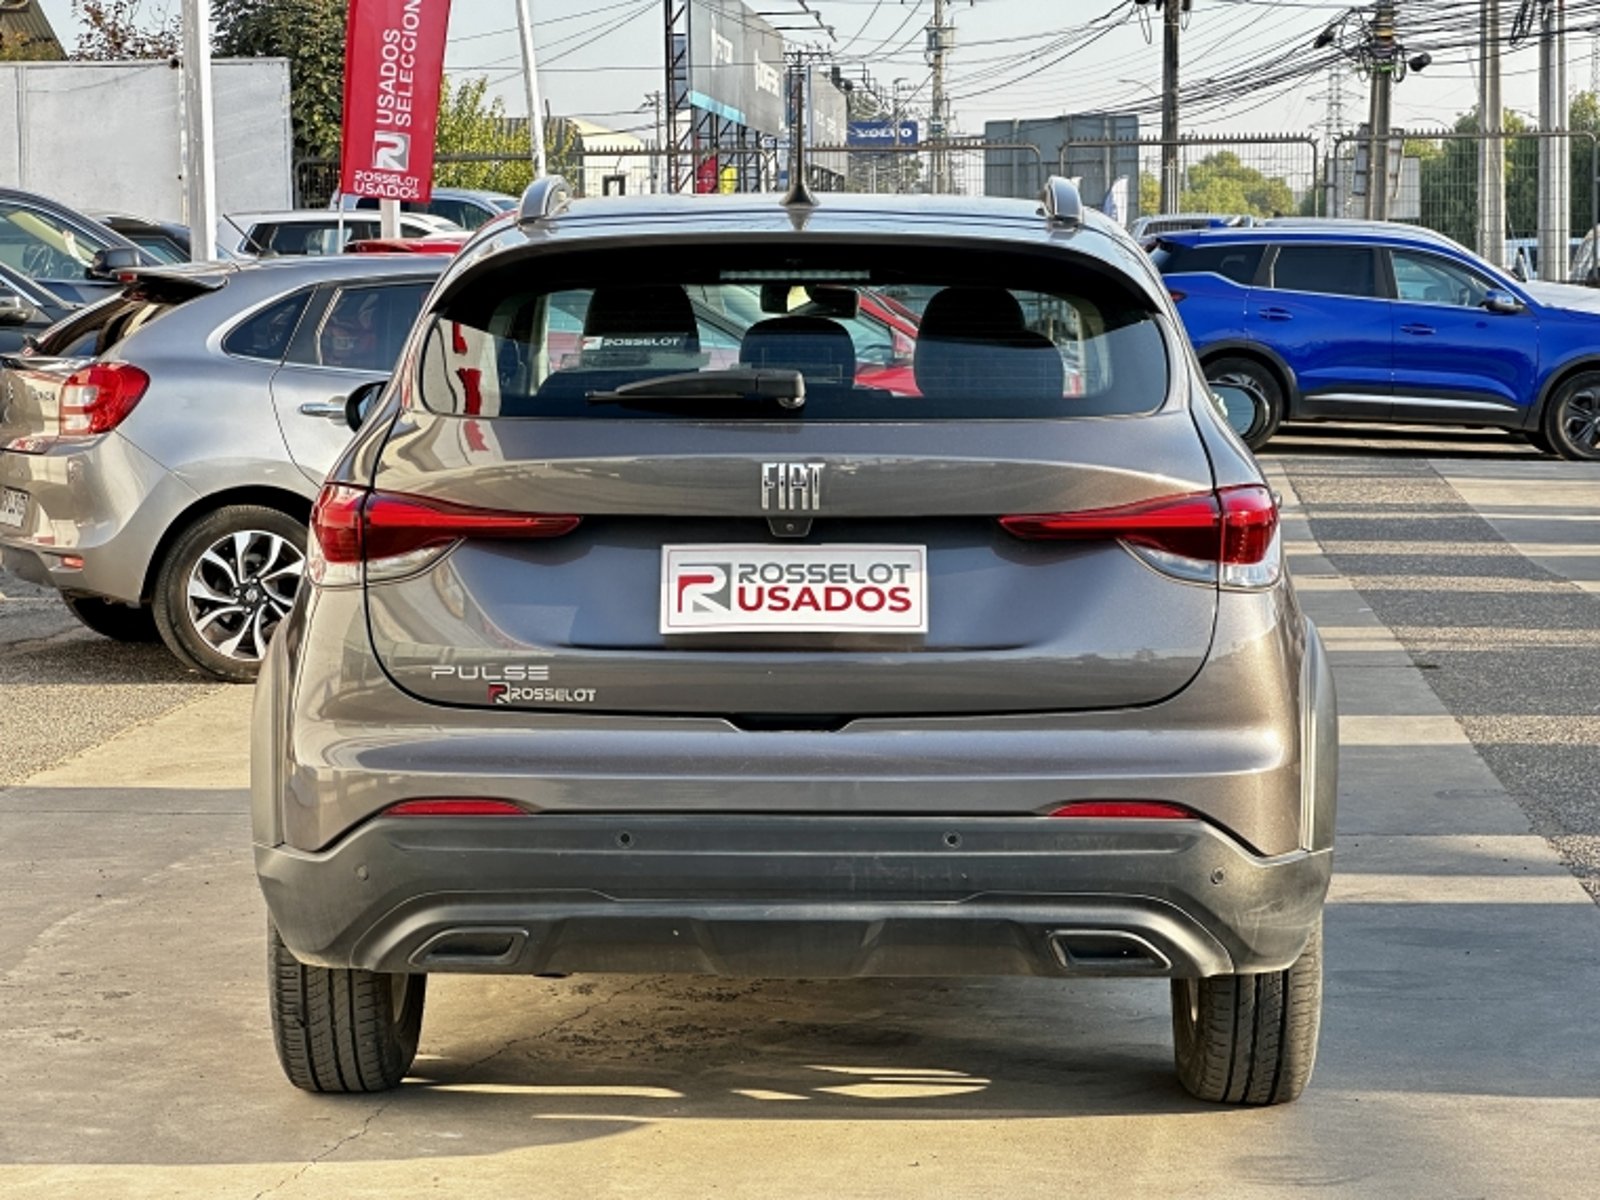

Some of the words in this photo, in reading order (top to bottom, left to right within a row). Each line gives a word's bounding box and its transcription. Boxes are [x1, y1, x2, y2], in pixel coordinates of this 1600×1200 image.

[376, 28, 401, 124] USADOS
[355, 170, 420, 188] ROSSELOT
[353, 181, 420, 199] USADOS
[762, 463, 826, 510] FIAT
[738, 563, 911, 584] ROSSELOT
[738, 587, 912, 612] USADOS
[431, 665, 549, 680] PULSE
[511, 687, 597, 702] ROSSELOT
